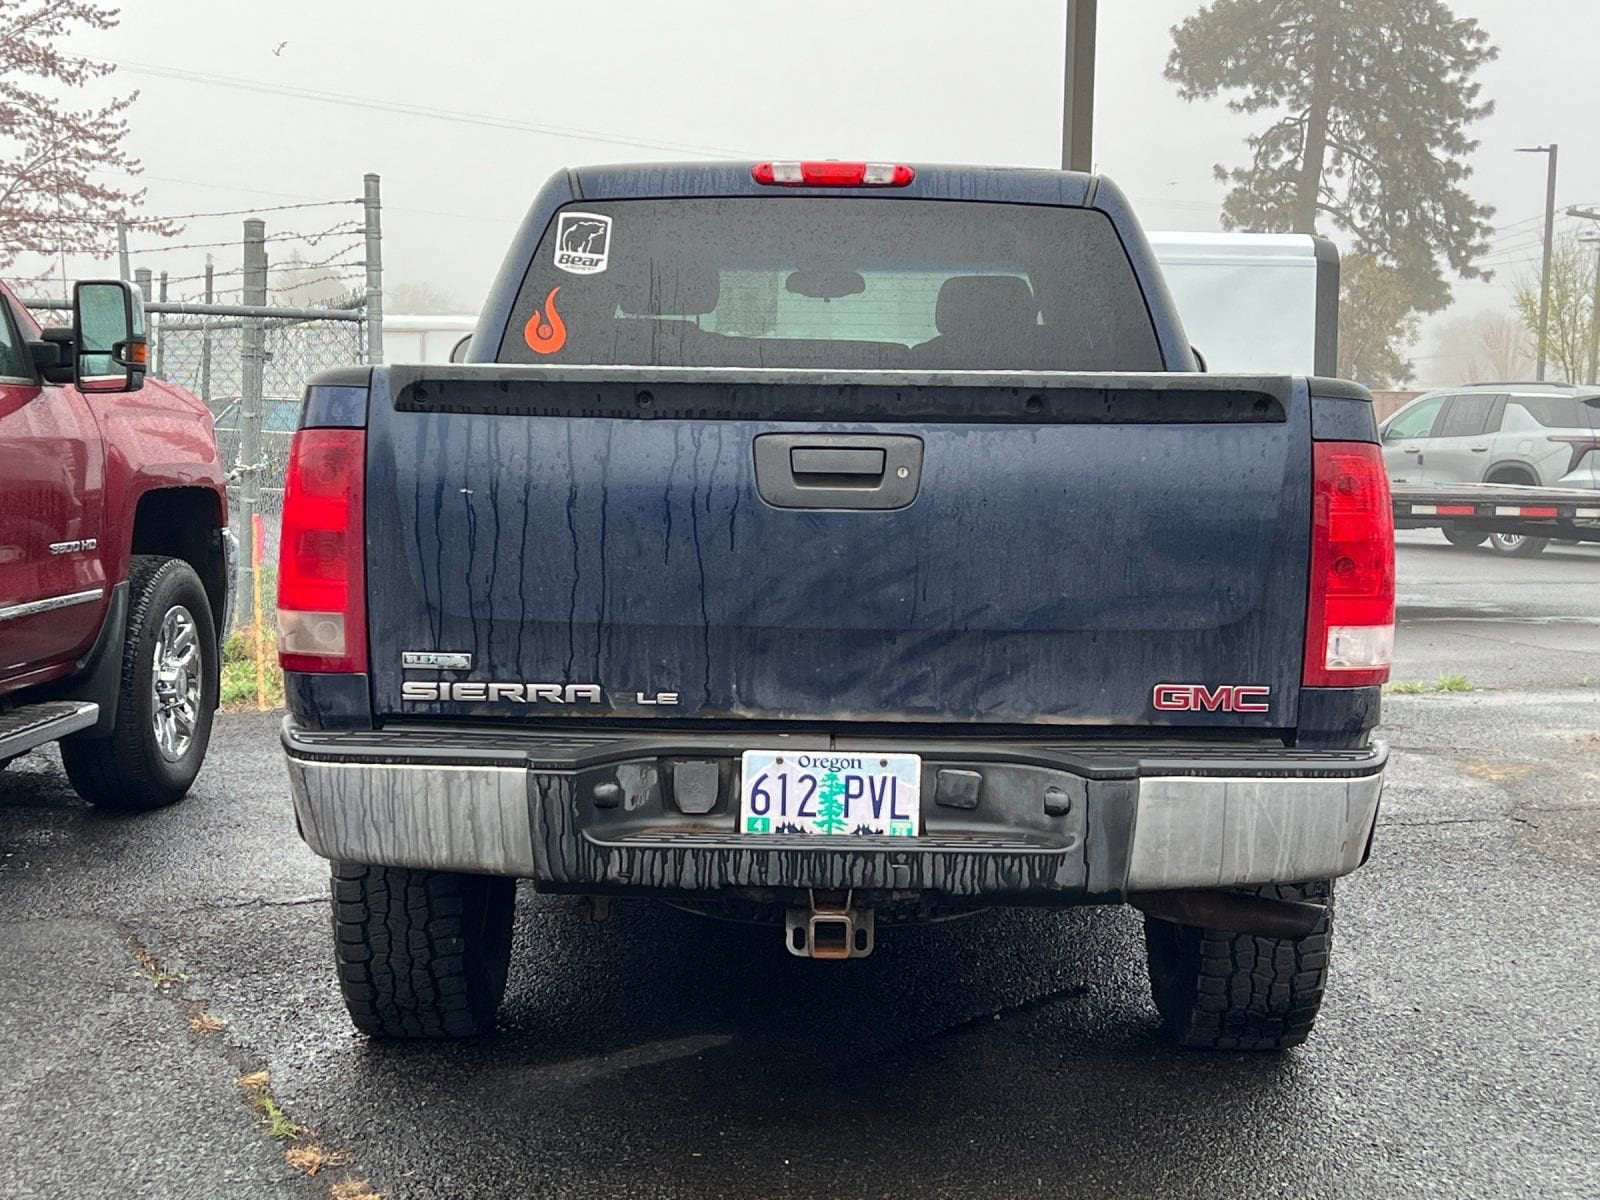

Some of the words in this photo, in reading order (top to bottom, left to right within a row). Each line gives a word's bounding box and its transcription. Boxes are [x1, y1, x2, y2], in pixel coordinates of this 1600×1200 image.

[558, 254, 604, 267] Bear
[80, 538, 97, 550] HD
[401, 681, 601, 703] SIERRA
[636, 692, 679, 705] LE
[1153, 683, 1270, 712] GMC
[798, 755, 863, 772] Oregon
[751, 773, 818, 817] 612
[843, 775, 910, 820] PVL
[753, 819, 763, 831] 4
